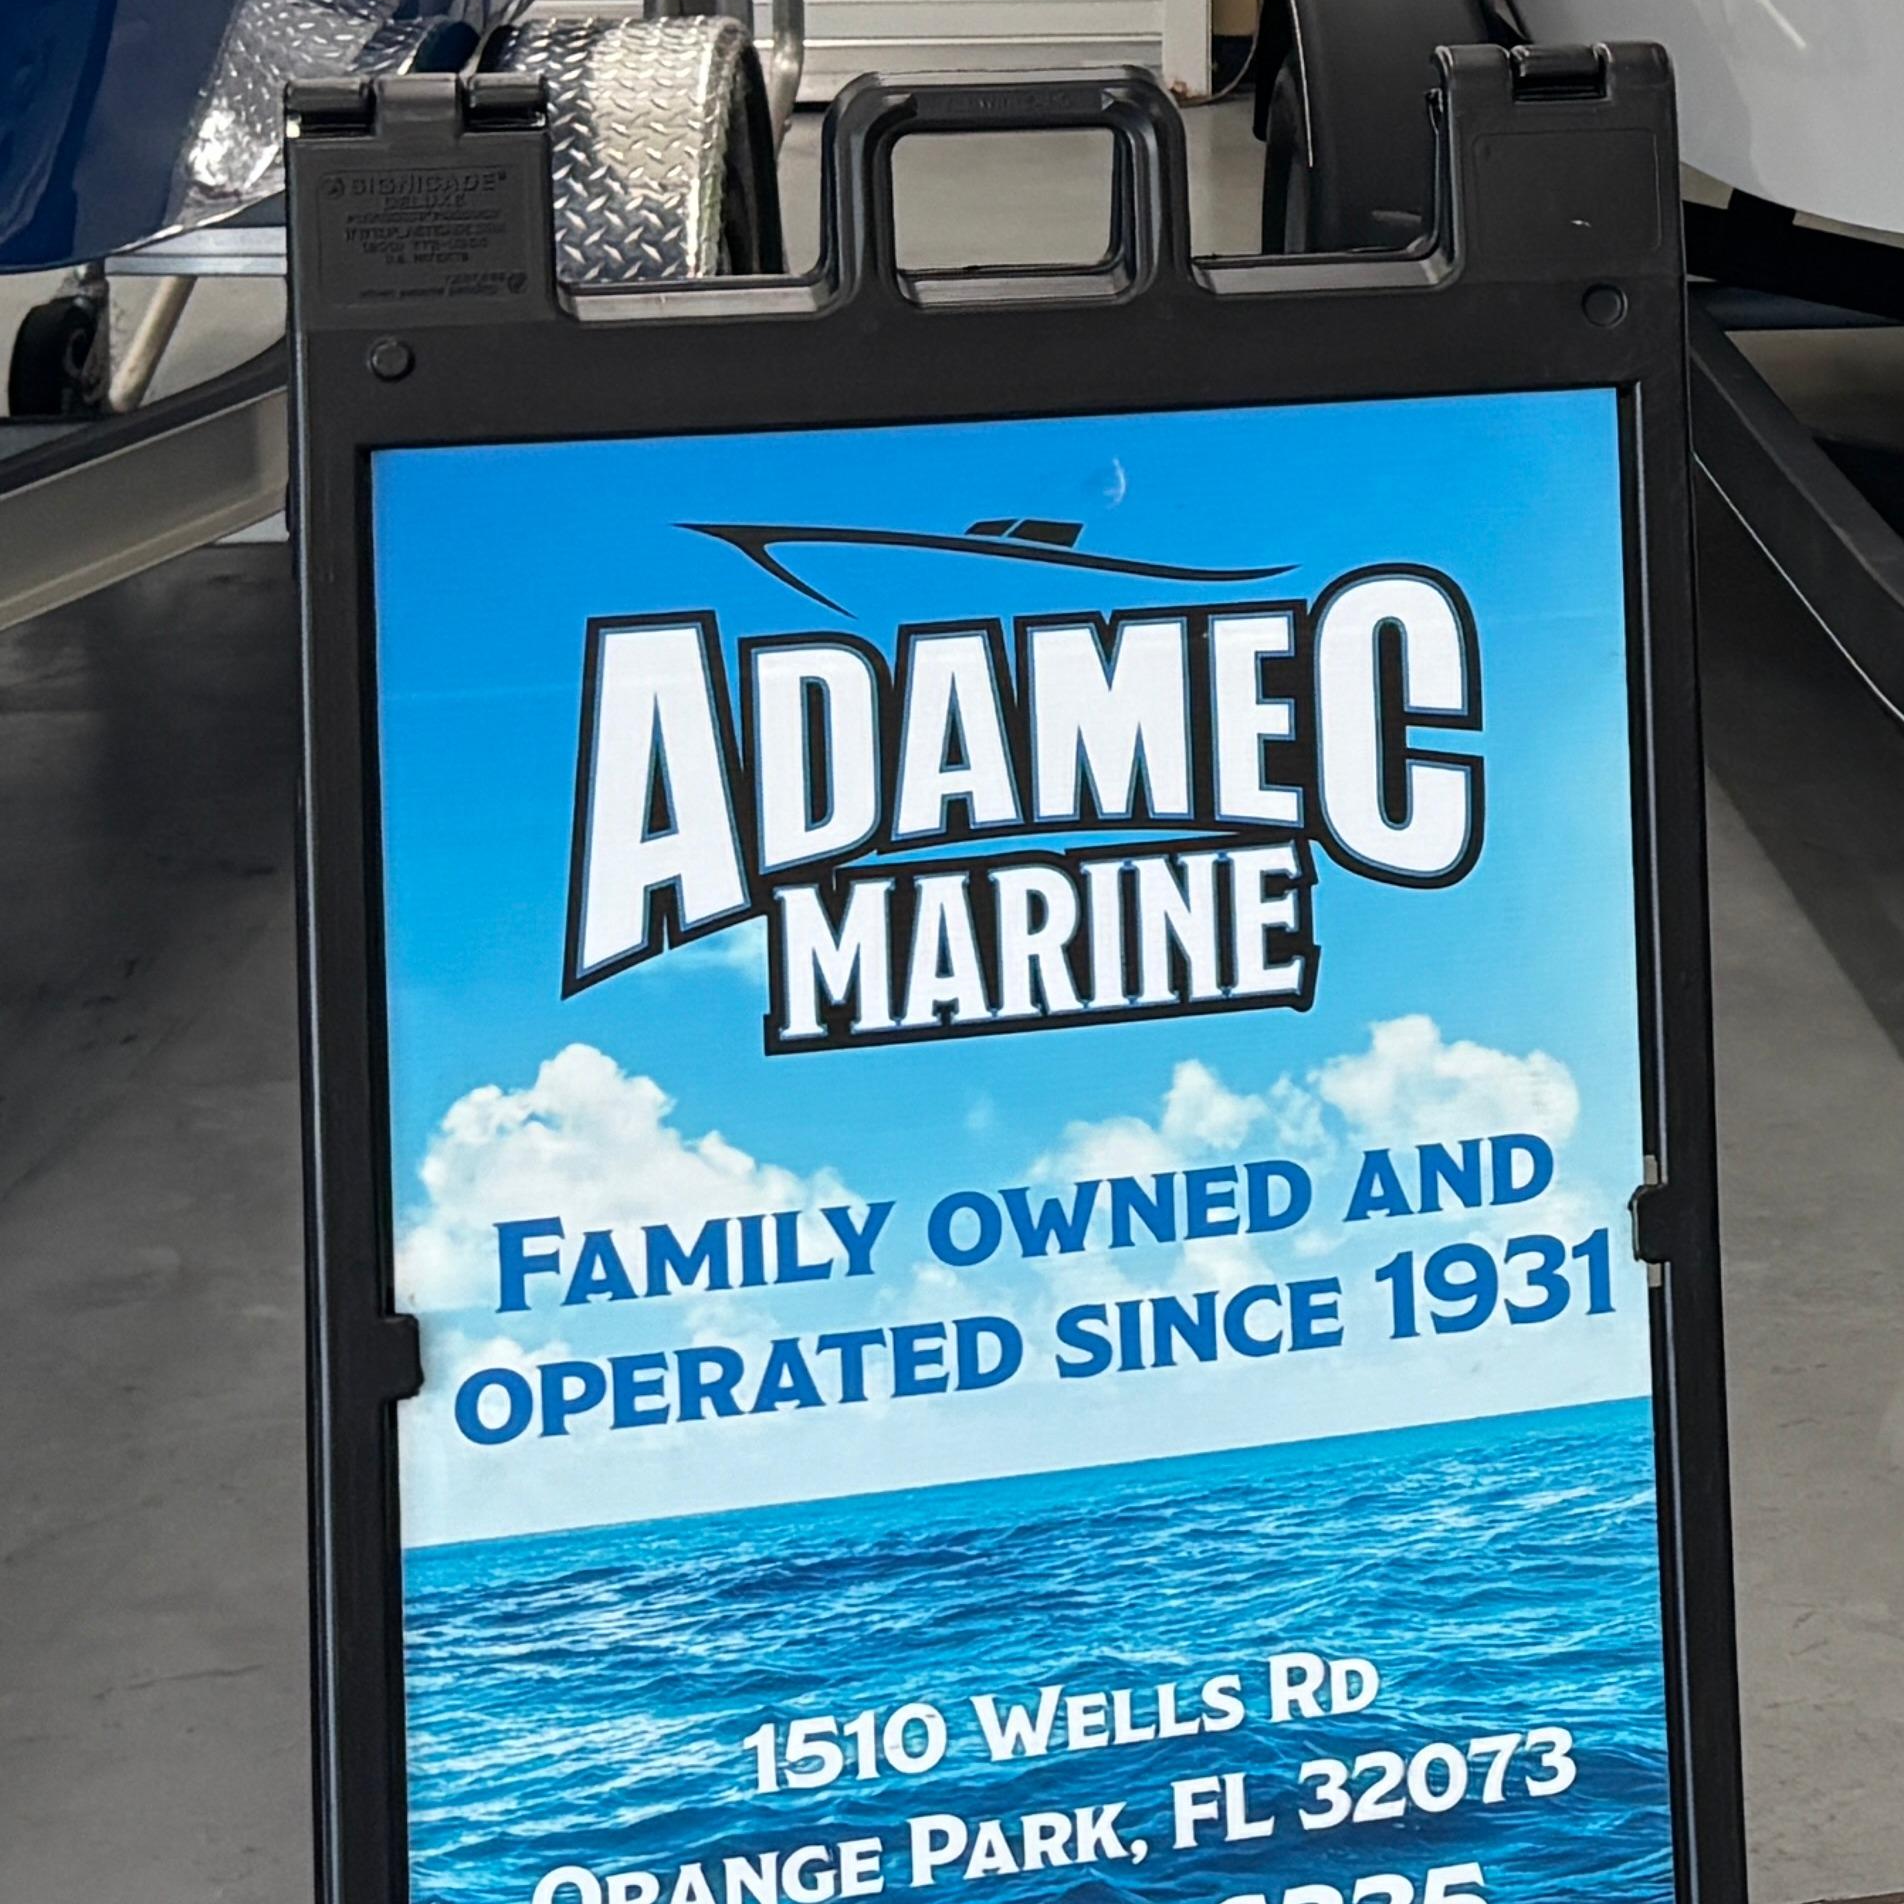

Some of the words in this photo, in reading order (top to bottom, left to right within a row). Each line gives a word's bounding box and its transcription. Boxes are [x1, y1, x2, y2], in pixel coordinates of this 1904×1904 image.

[562, 563, 1485, 998] ADAMEC
[768, 839, 1316, 1051] MARINE
[496, 1199, 893, 1313] FAMILY
[927, 1158, 1312, 1266] OWNED
[1342, 1131, 1556, 1223] AND
[453, 1313, 1024, 1445] OPERATED
[1056, 1282, 1344, 1380] SINCE
[1376, 1226, 1616, 1339] 1931
[743, 1713, 947, 1793] 1510
[971, 1671, 1246, 1761] WELLS
[909, 1796, 1149, 1888] PARK,
[1172, 1772, 1276, 1851] FL
[1296, 1726, 1578, 1832] 32073
